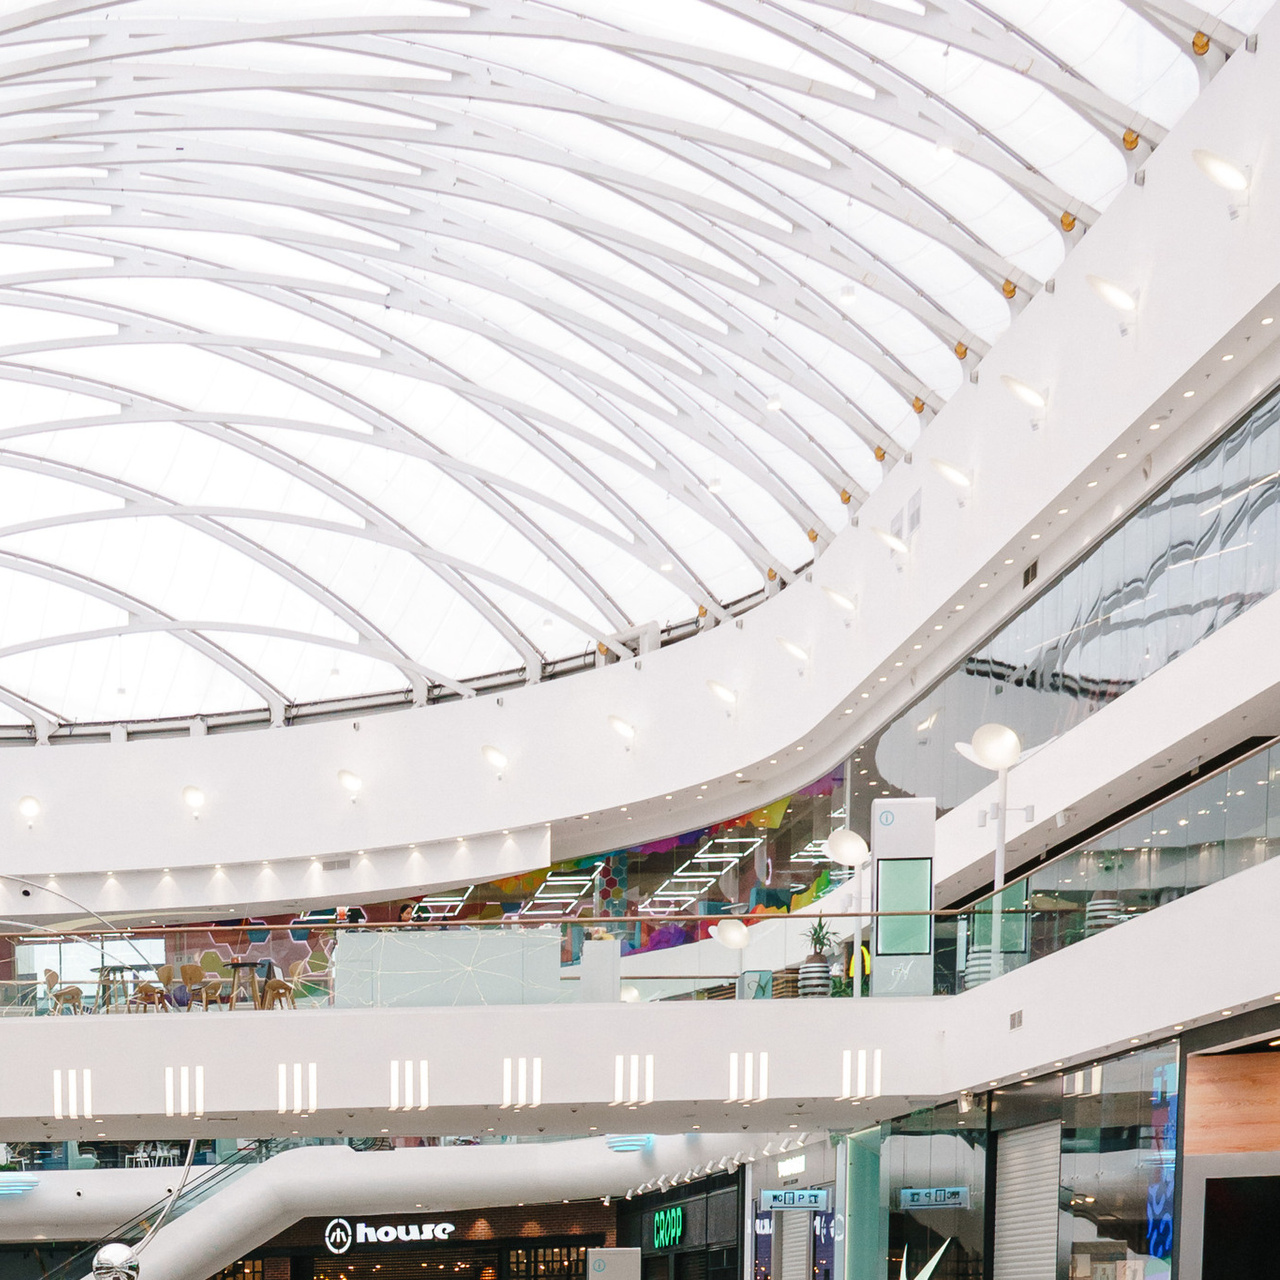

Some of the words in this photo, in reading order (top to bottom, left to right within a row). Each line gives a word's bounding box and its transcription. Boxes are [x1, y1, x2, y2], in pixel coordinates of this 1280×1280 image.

[772, 1194, 783, 1203] WC
[797, 1194, 805, 1202] P
[356, 1222, 455, 1243] house
[654, 1206, 683, 1249] CROPP
